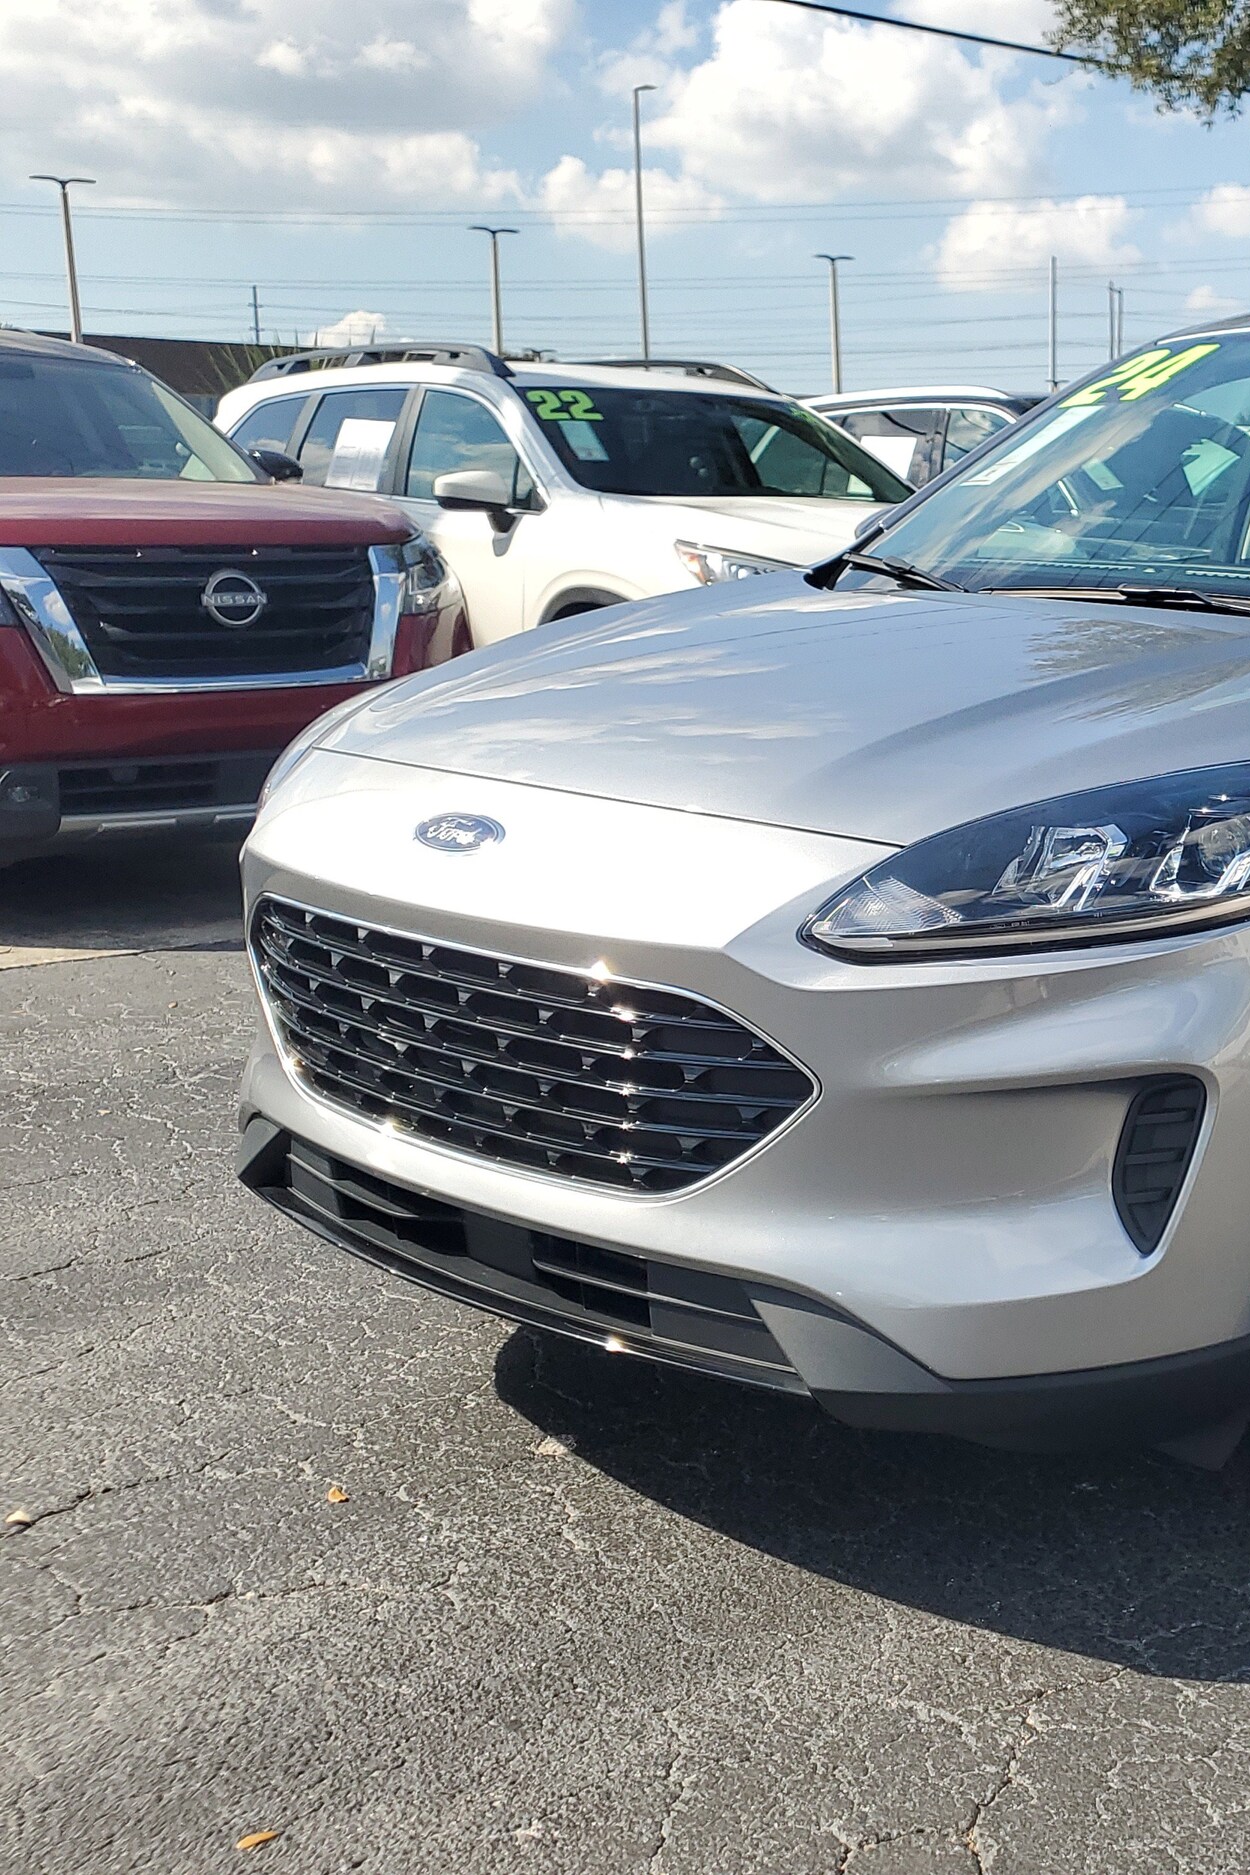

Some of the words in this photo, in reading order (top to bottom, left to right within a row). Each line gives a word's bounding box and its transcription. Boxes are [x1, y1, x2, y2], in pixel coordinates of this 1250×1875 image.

[1057, 342, 1222, 409] 24
[525, 389, 605, 421] 22
[203, 594, 267, 605] NISSAN
[426, 816, 483, 845] Ford
